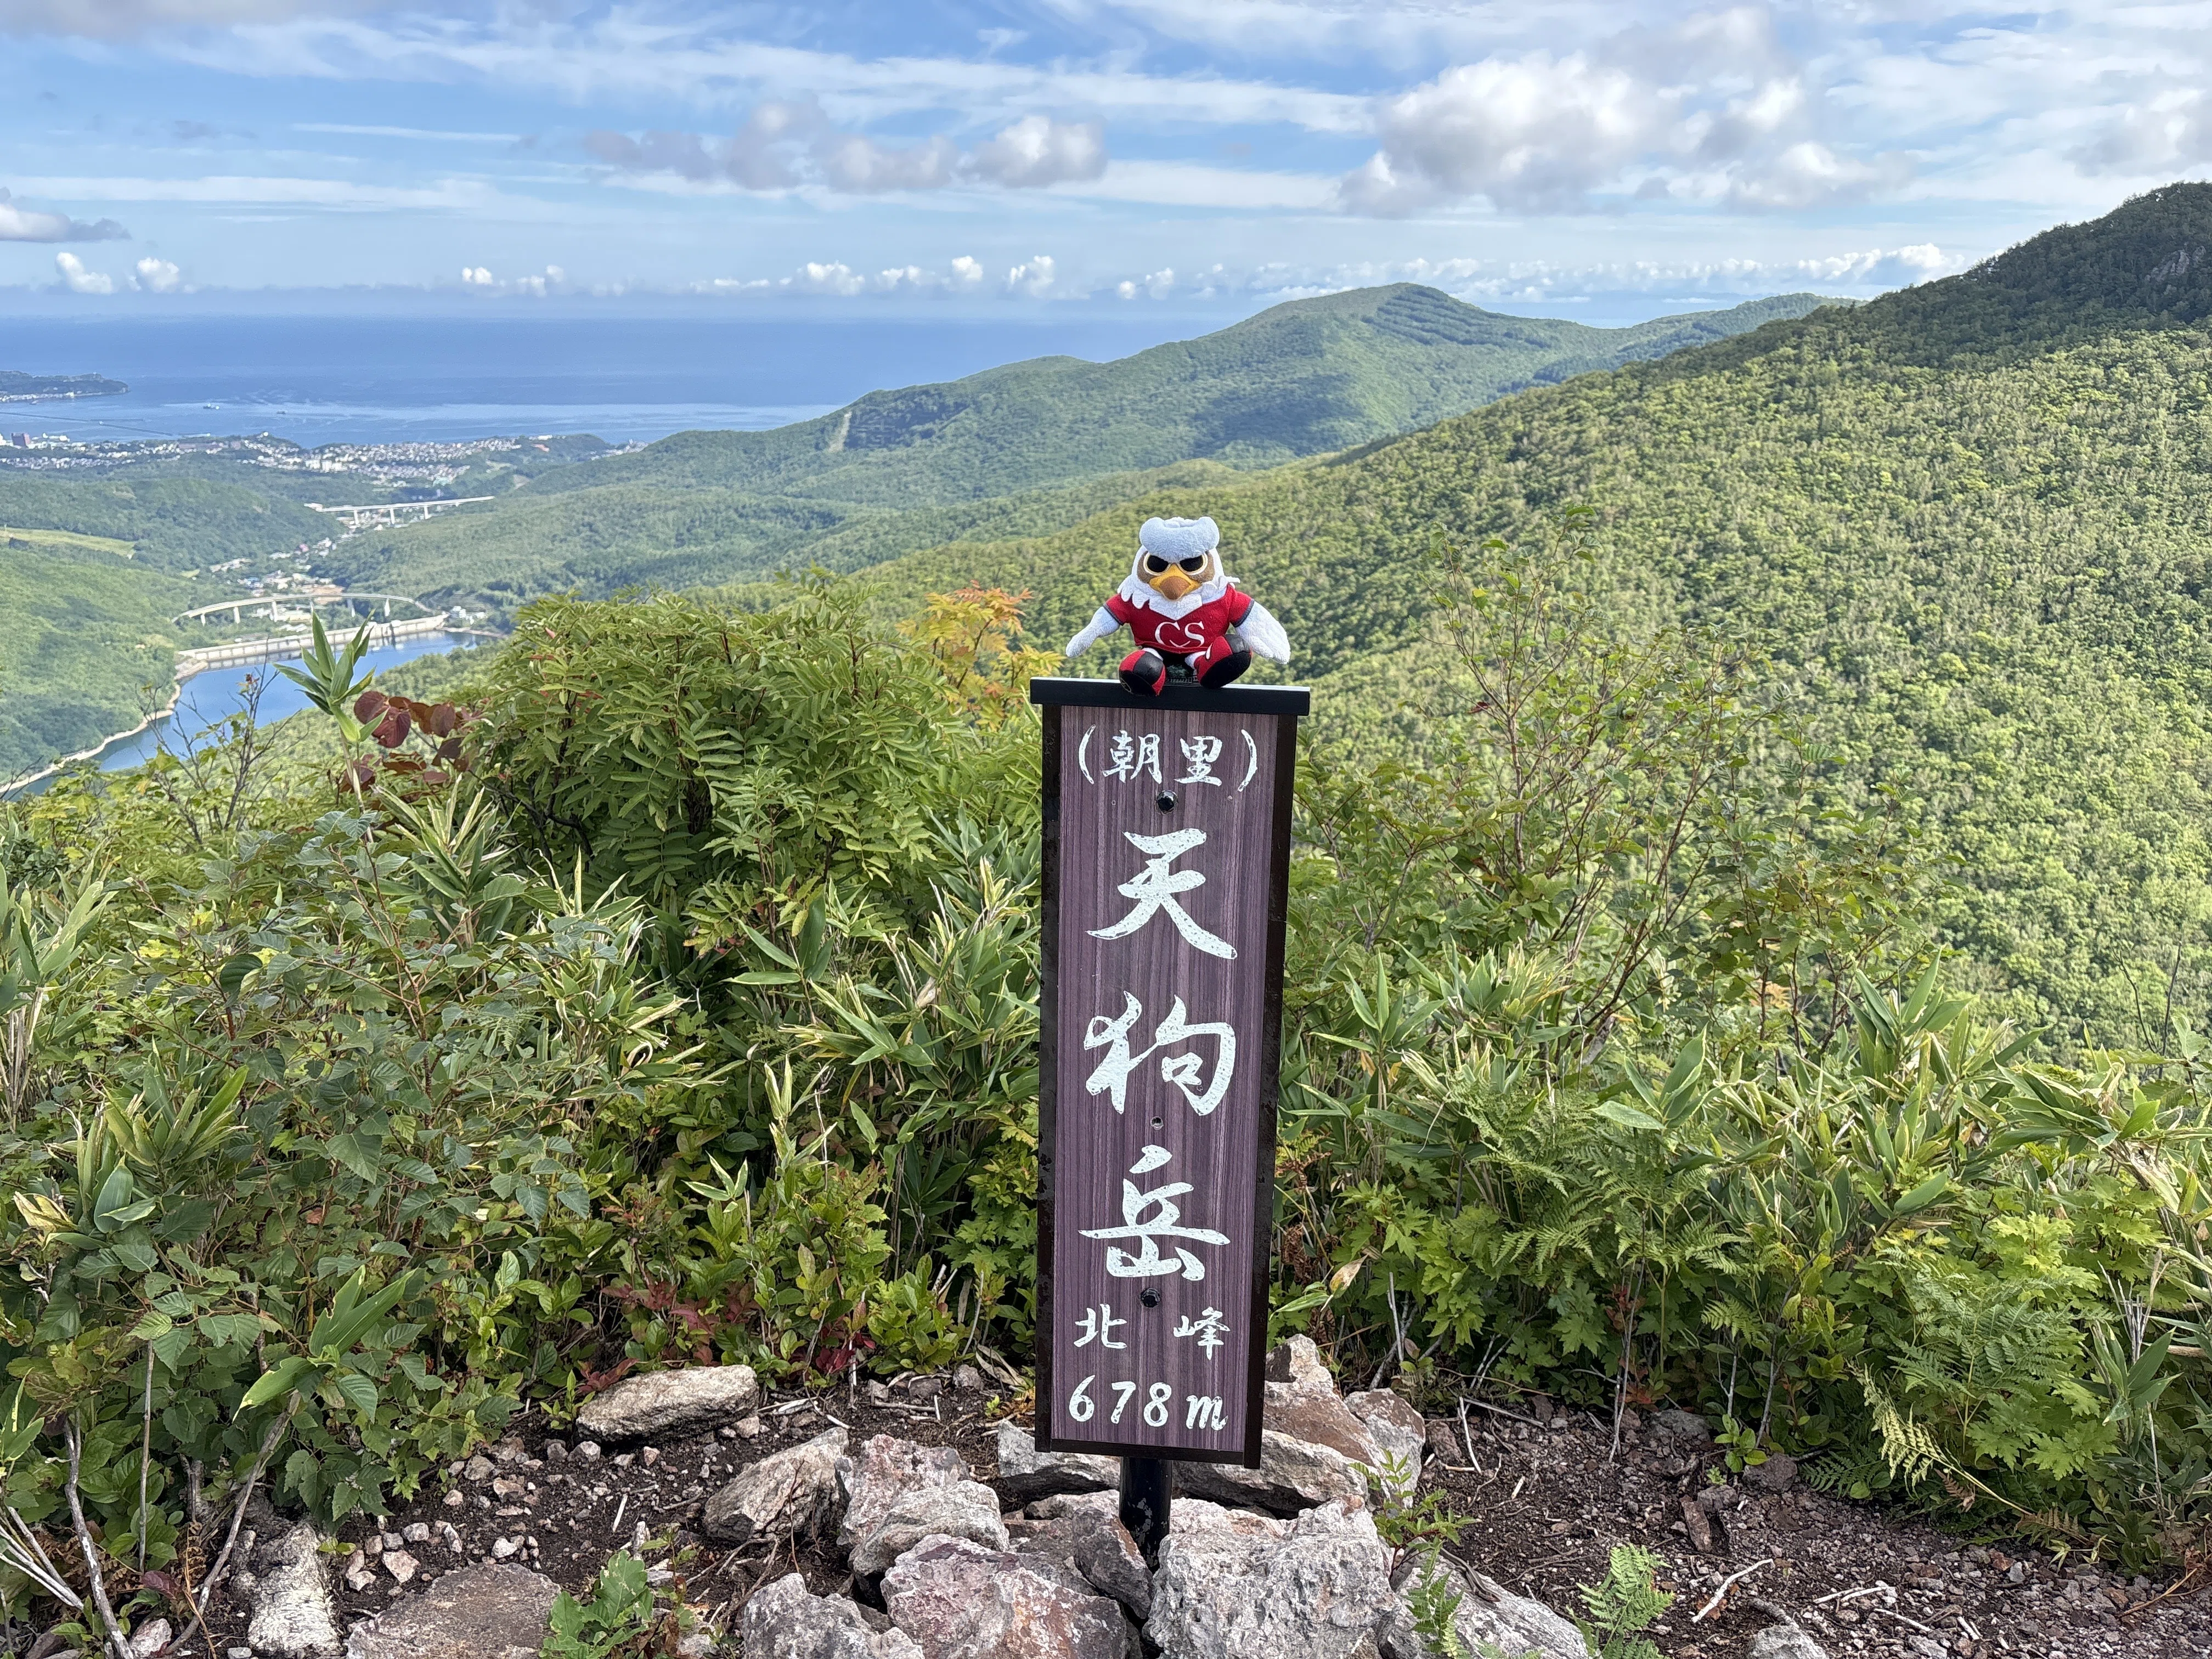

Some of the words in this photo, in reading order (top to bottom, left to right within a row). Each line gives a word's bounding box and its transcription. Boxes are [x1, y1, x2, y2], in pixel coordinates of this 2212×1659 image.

[1079, 725, 1257, 792] (朝里)
[1079, 828, 1237, 1281] 天狗岳
[1069, 1374, 1228, 1431] 678m
